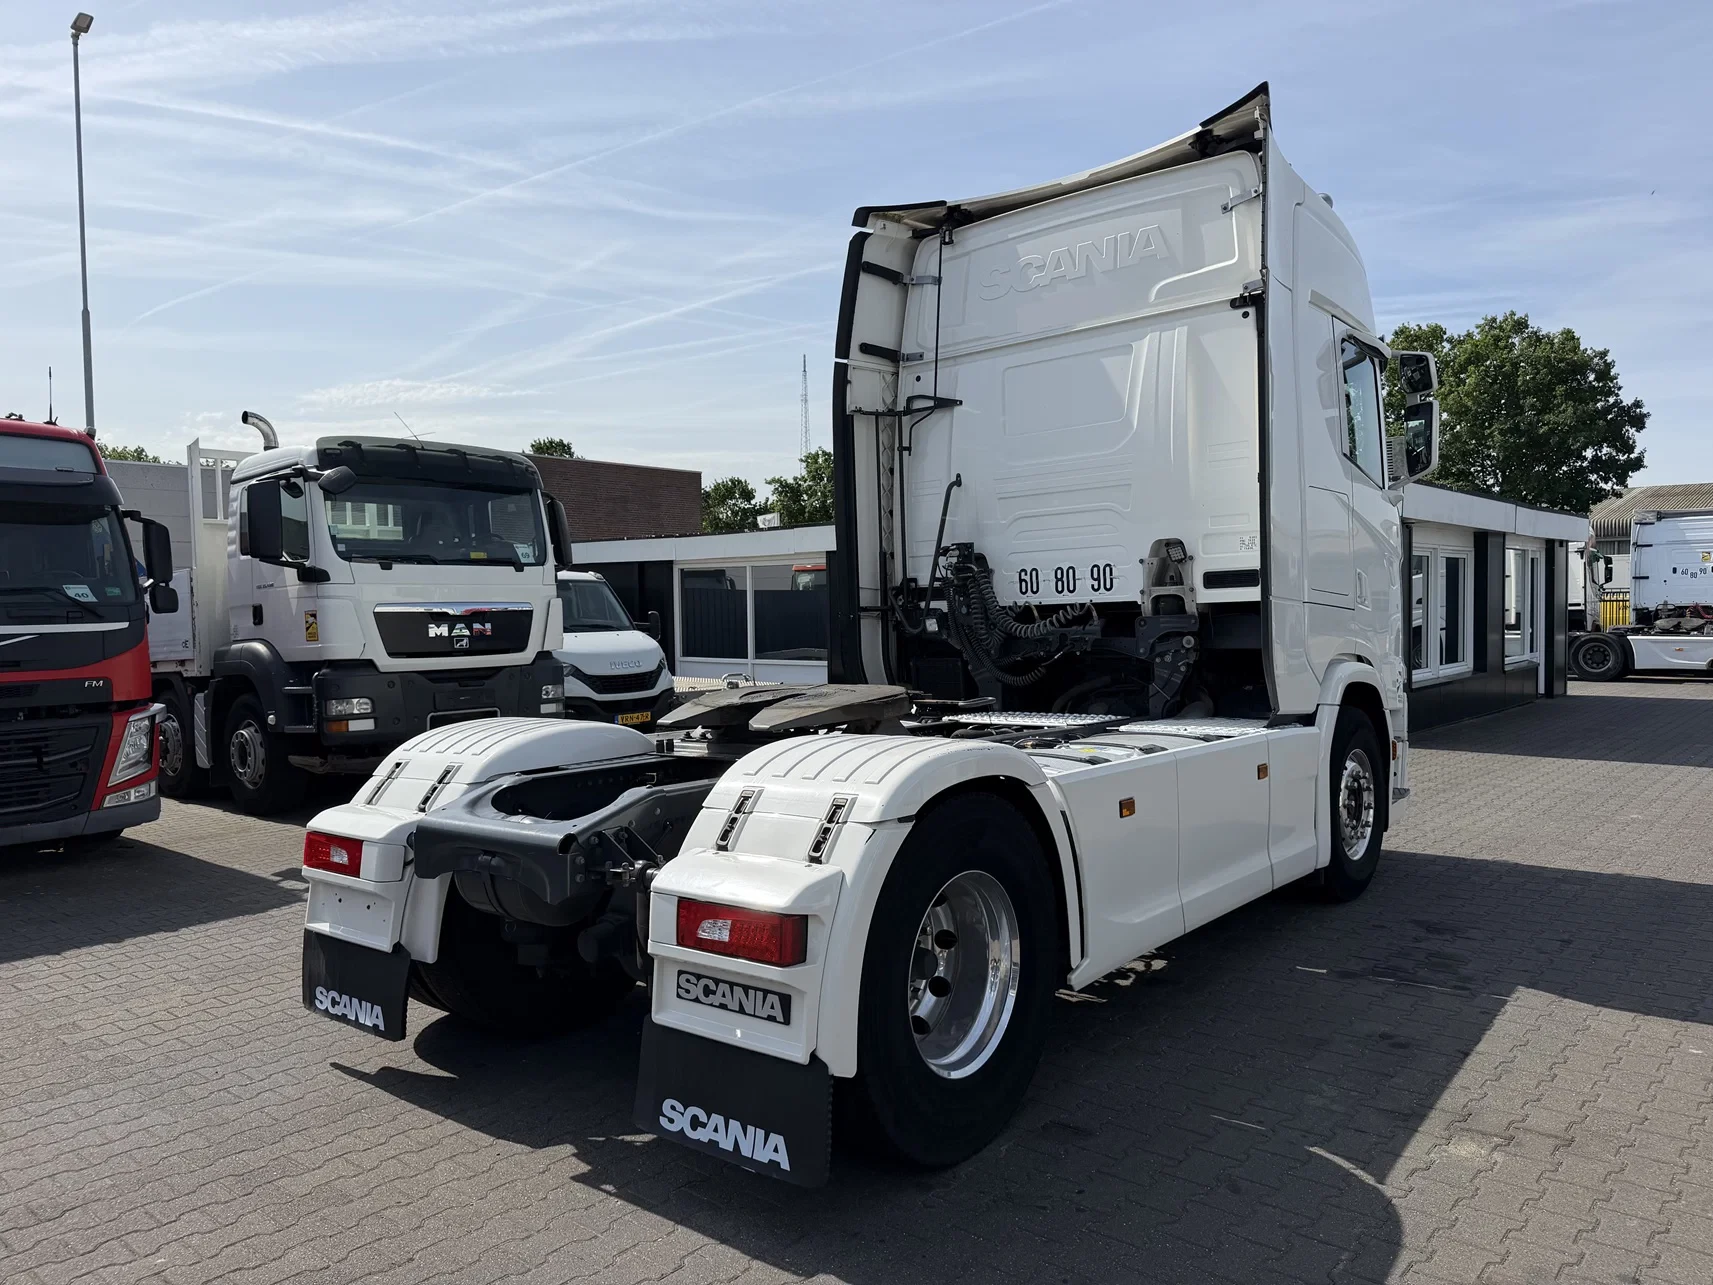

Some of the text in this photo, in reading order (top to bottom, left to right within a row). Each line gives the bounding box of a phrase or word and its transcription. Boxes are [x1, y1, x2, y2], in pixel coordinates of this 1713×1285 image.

[978, 224, 1171, 302] SCANIA
[1019, 563, 1114, 596] 60 80 90
[1680, 567, 1707, 579] 60 80 90
[428, 623, 492, 638] MAN
[609, 660, 643, 670] IVECO
[84, 680, 104, 688] FM
[314, 985, 385, 1031] SCANIA
[677, 973, 785, 1023] SCANIA
[659, 1098, 791, 1172] SCANIA
